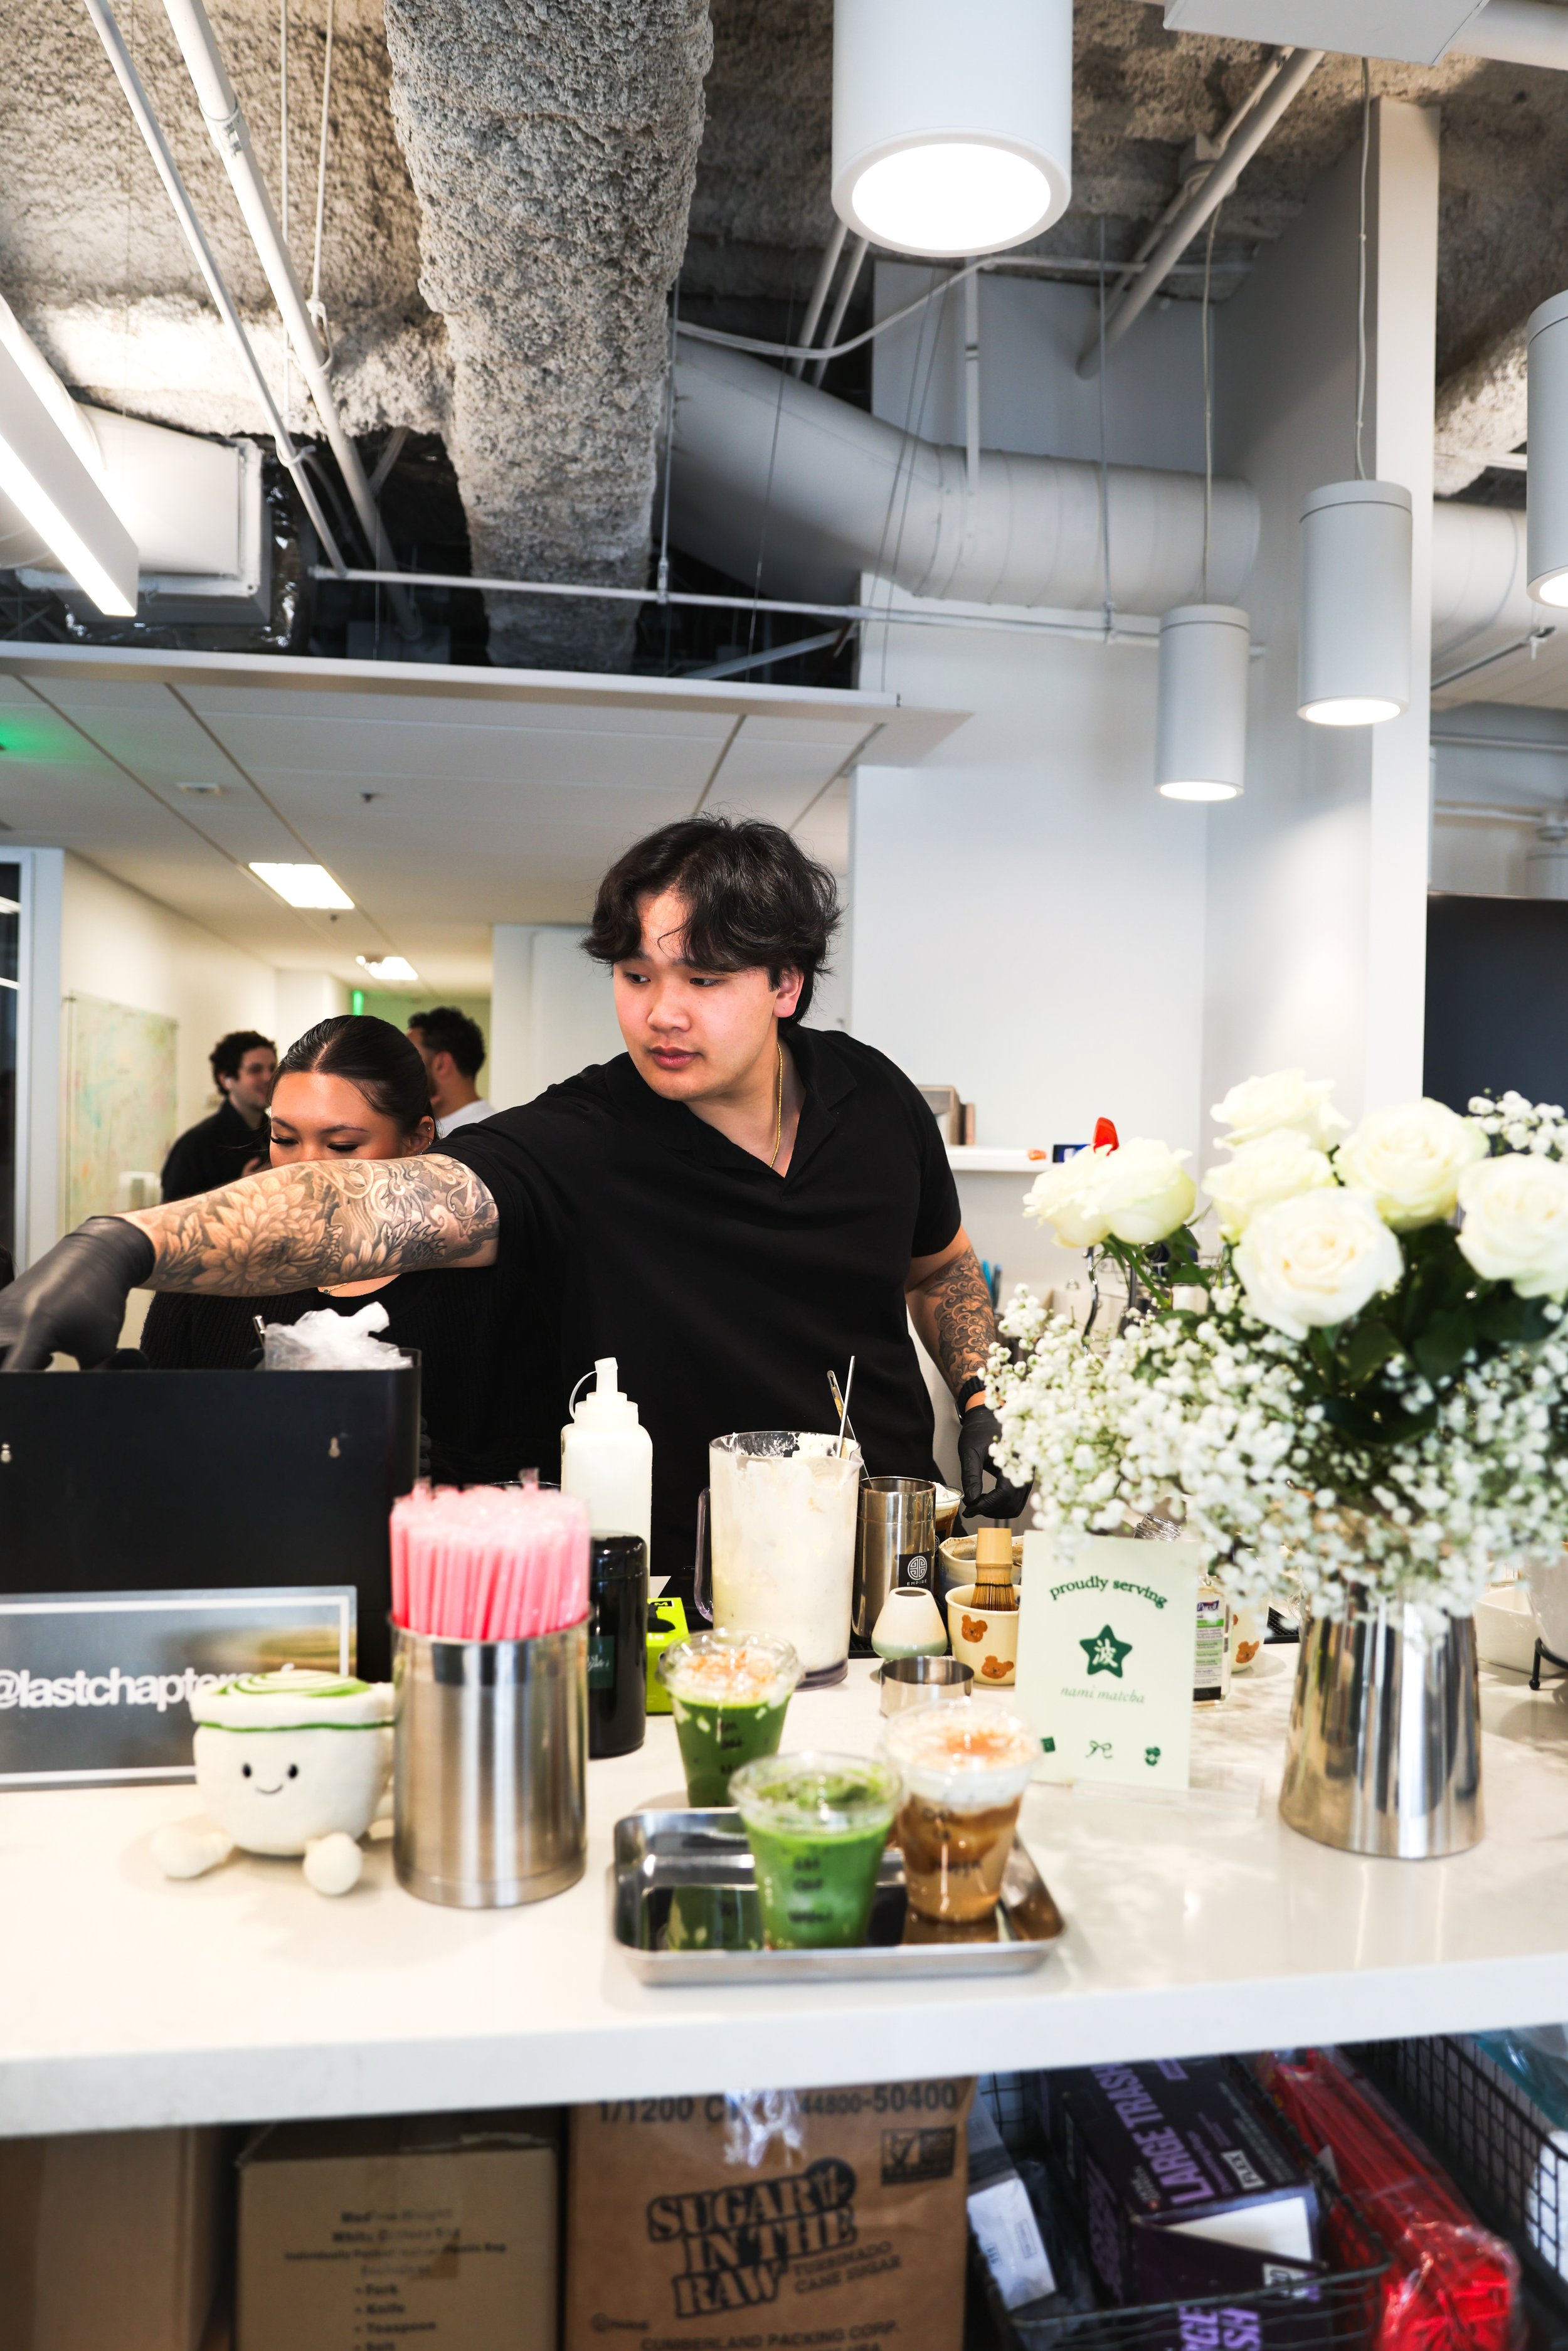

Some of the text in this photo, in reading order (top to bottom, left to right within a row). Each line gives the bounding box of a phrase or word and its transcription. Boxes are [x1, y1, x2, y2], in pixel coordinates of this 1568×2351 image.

[1050, 1576, 1167, 1609] proudly serving
[1061, 1685, 1145, 1704] nami matcha
[1131, 2126, 1214, 2204] LARGE
[650, 2175, 817, 2241] SUGAR
[686, 2204, 856, 2273] IN THE
[675, 2259, 783, 2316] RAW
[795, 2270, 842, 2295] CANE
